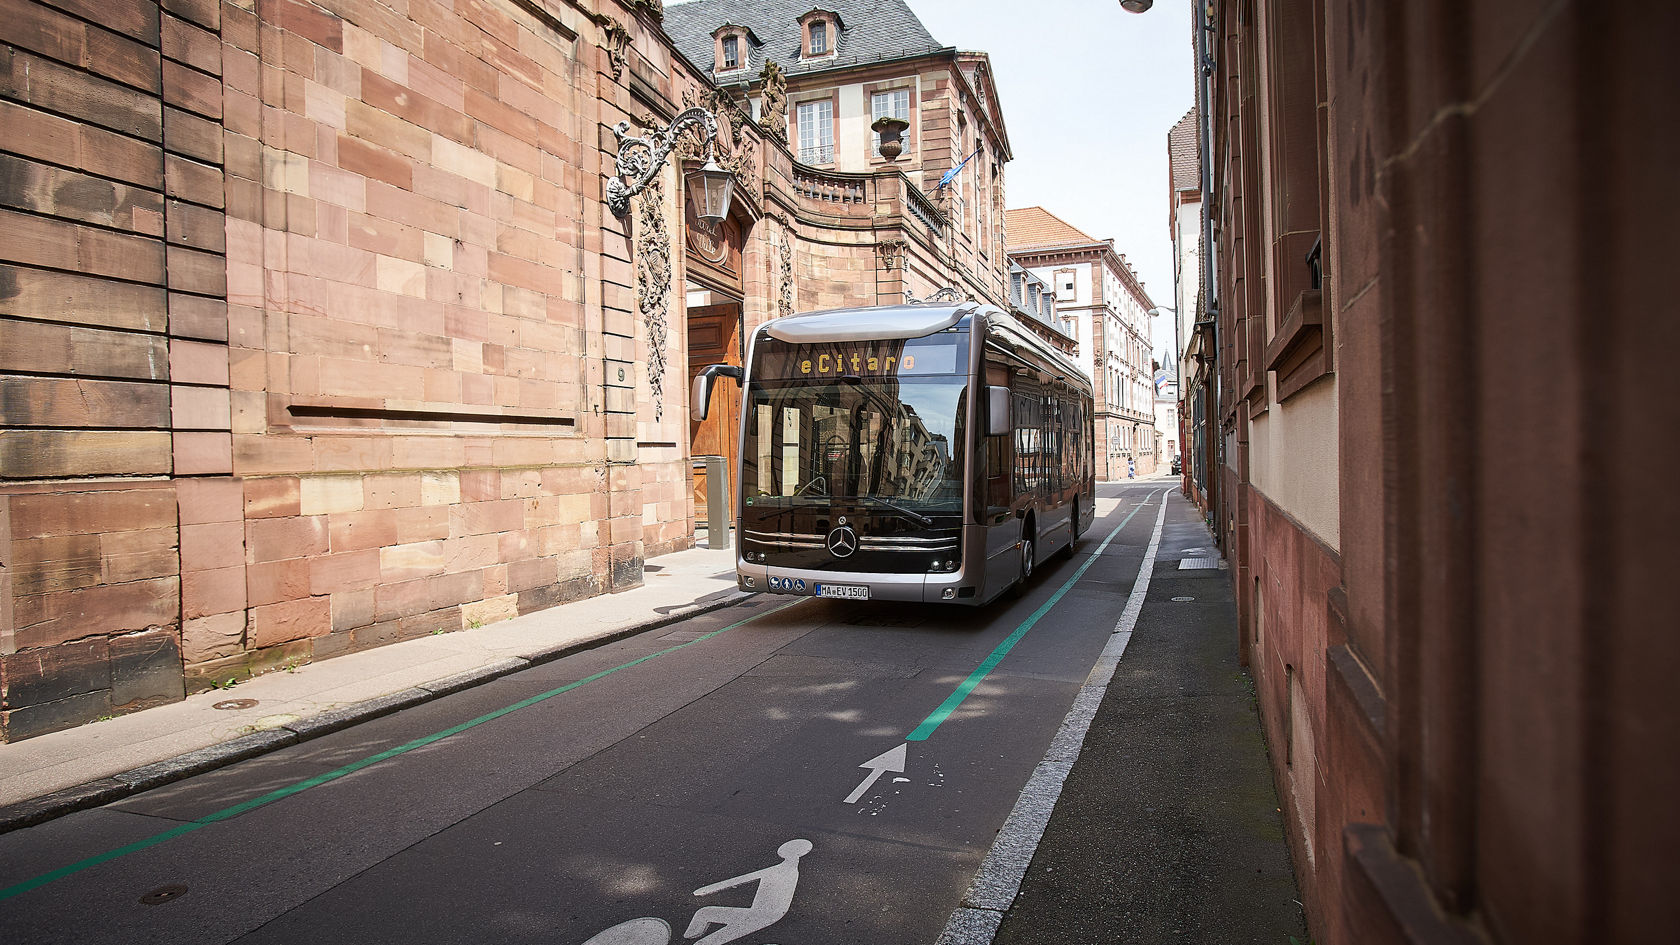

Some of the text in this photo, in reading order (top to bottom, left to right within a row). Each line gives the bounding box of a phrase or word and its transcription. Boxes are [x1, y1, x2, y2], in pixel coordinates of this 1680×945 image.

[800, 352, 915, 374] eCitaro
[617, 367, 625, 382] 9
[821, 585, 832, 596] MA
[836, 586, 847, 597] EV
[847, 587, 868, 598] 1500
